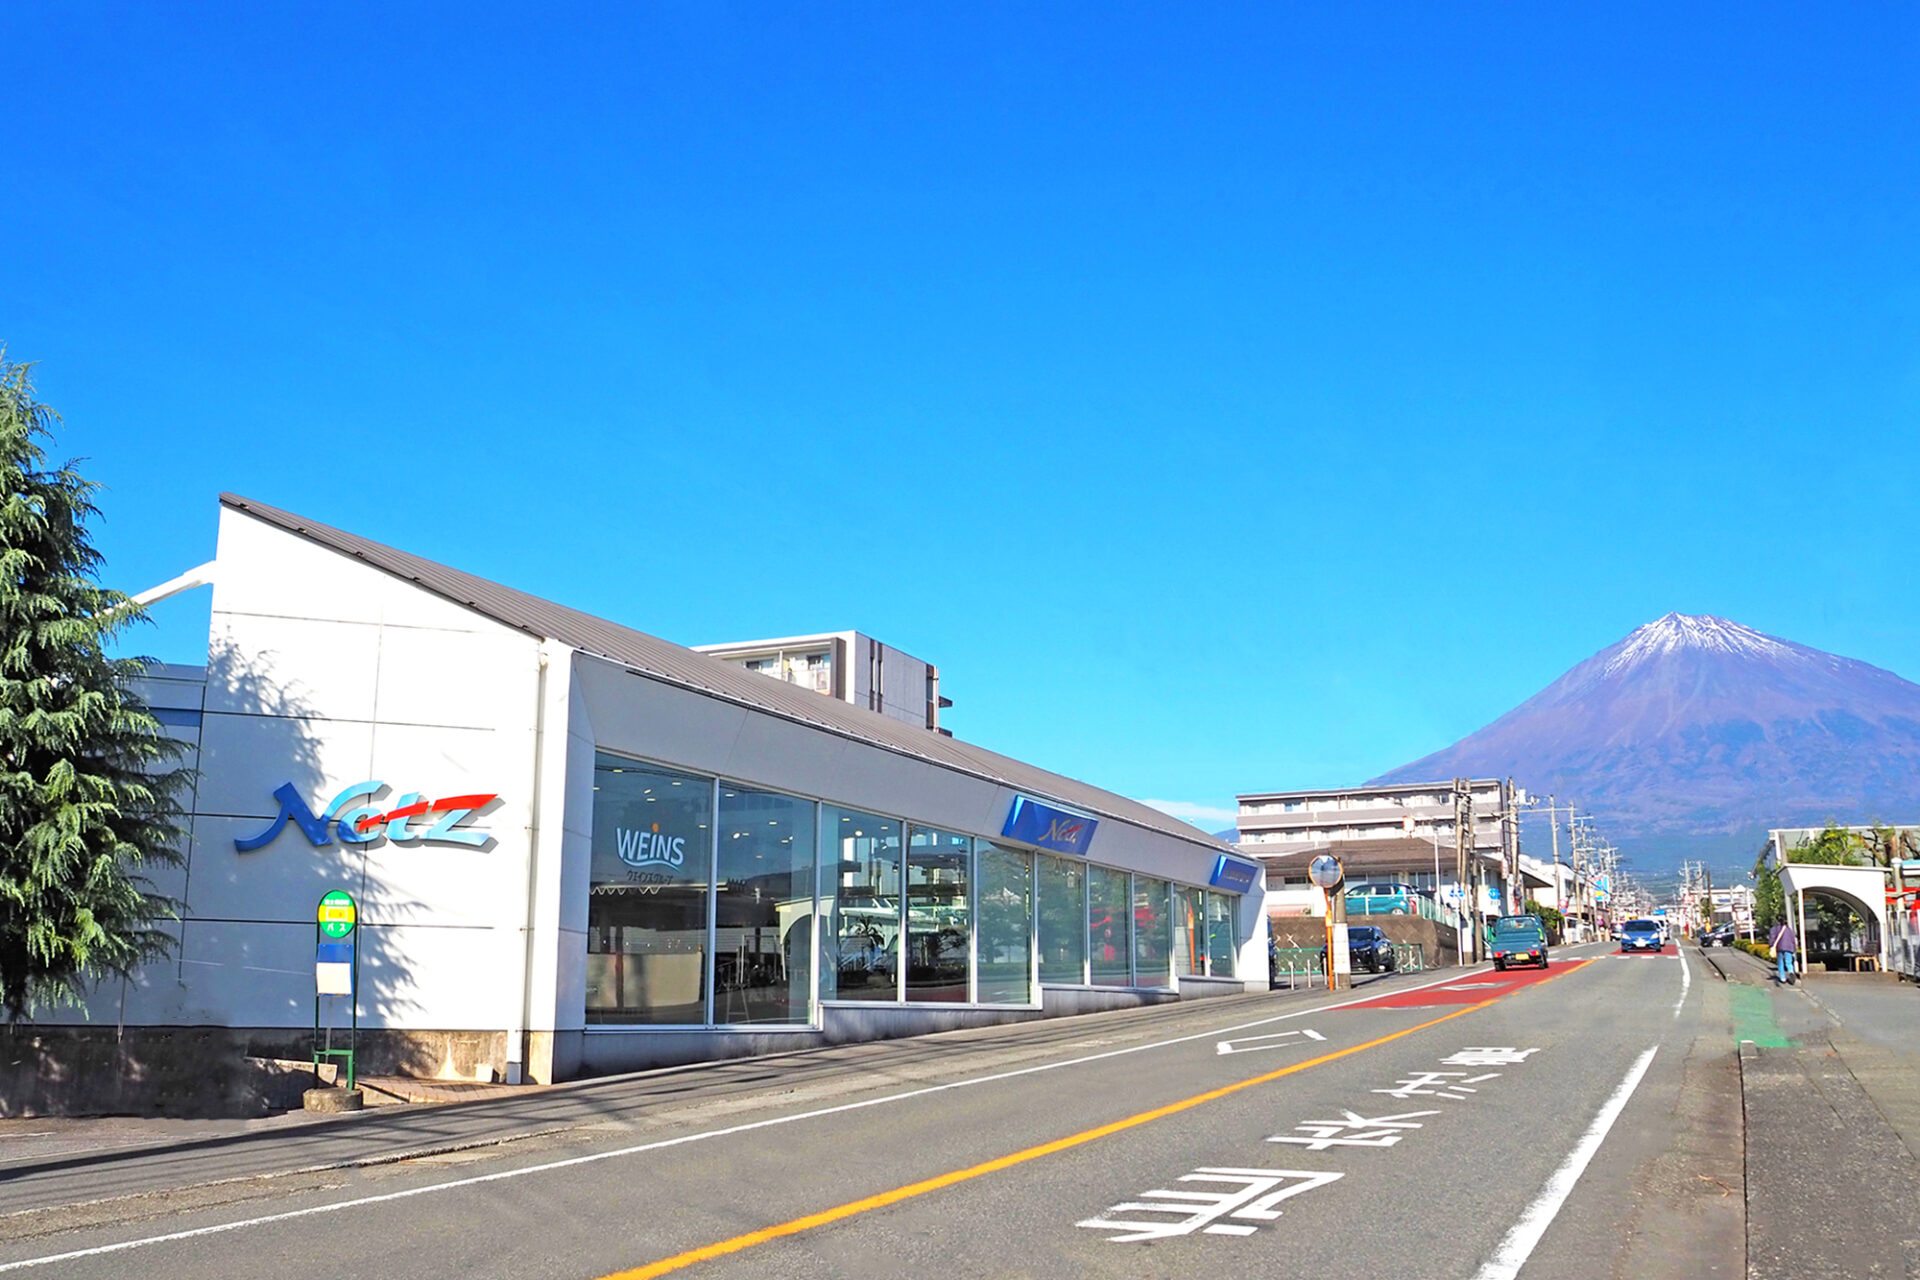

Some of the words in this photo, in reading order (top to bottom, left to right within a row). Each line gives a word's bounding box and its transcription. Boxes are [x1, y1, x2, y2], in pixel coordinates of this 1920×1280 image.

[234, 780, 498, 852] Netz
[1075, 1046, 1541, 1243] 追突注意
